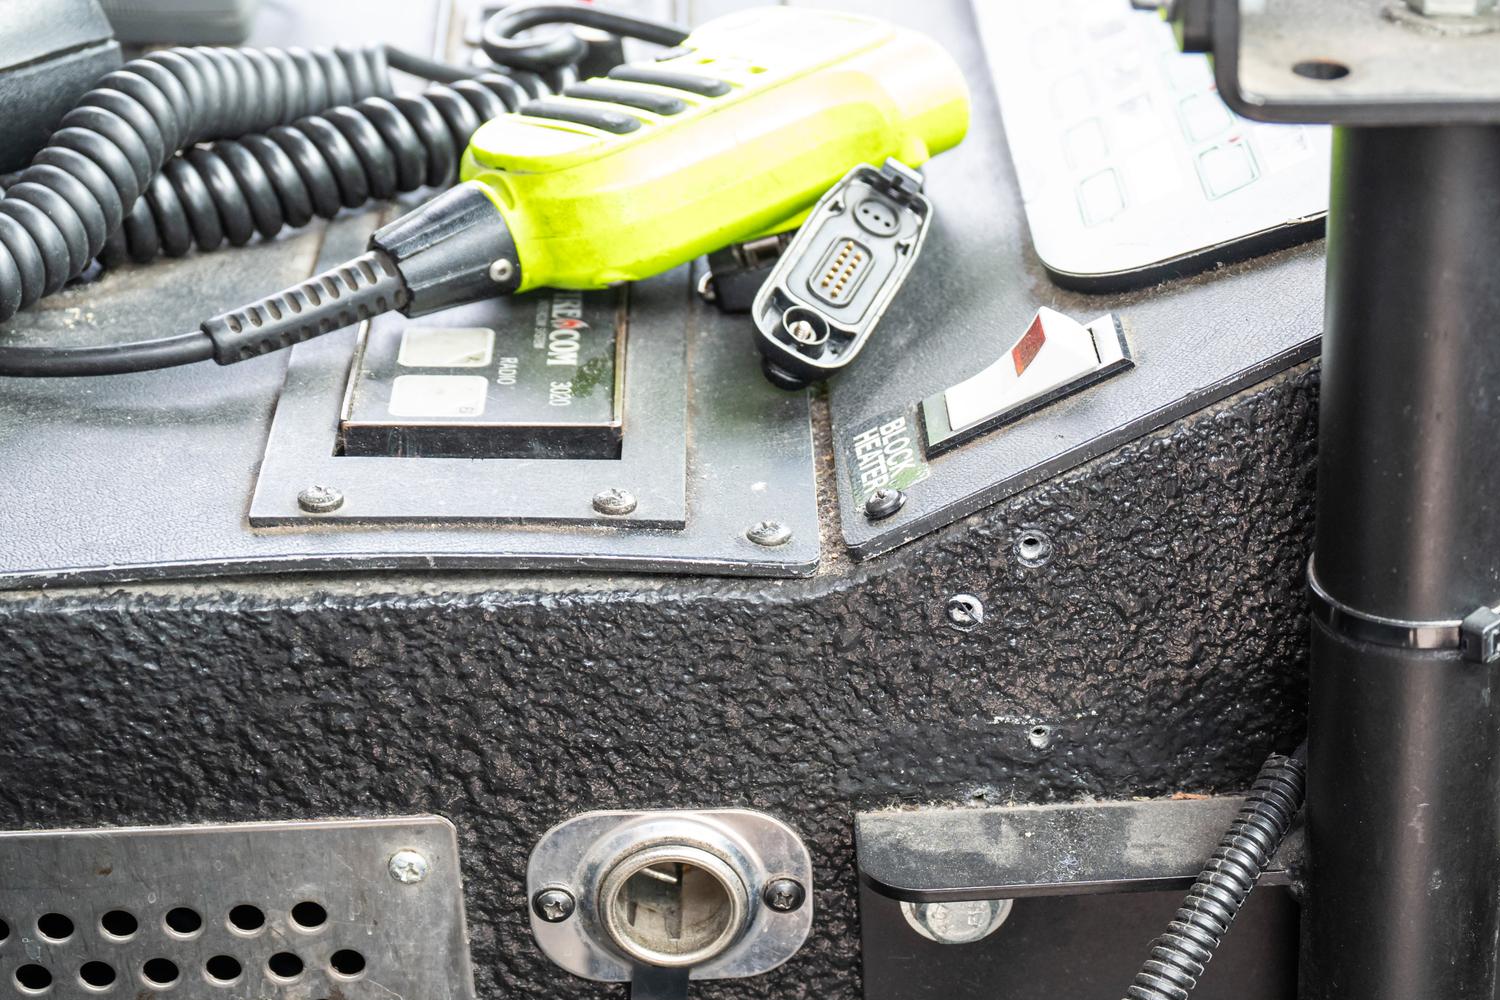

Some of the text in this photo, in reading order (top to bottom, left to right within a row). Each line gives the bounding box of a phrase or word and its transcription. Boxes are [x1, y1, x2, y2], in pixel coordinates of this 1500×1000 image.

[497, 357, 518, 385] RADIO
[546, 293, 583, 406] IRECOM 3020
[853, 426, 889, 494] HEATER
[880, 416, 916, 479] BLOCK
